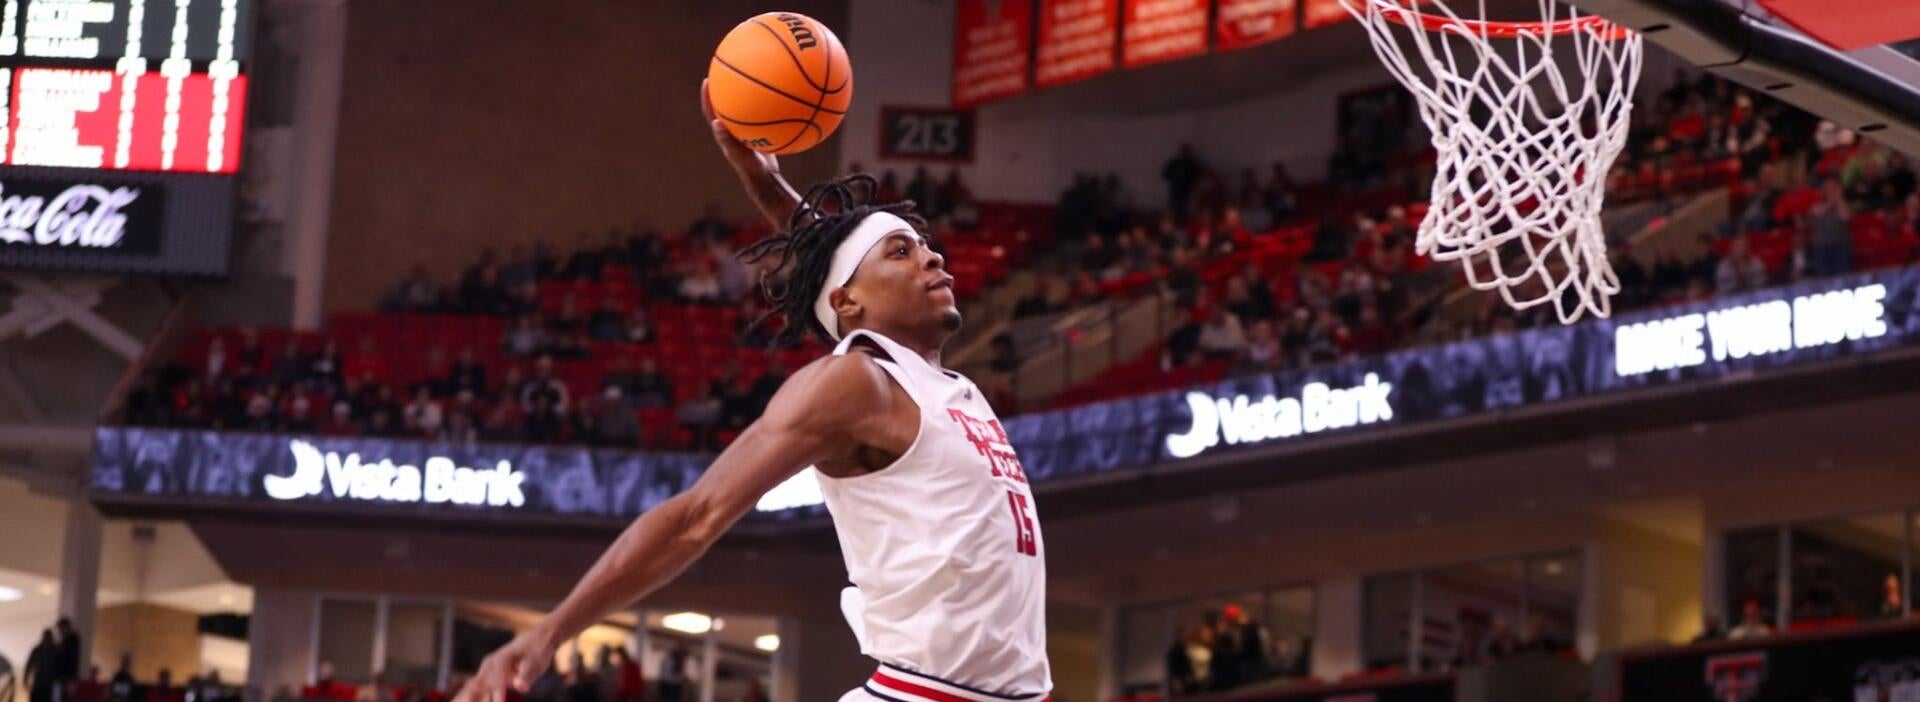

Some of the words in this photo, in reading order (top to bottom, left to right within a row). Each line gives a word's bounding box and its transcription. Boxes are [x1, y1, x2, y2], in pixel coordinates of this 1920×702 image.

[897, 117, 959, 151] 213
[1615, 313, 1706, 376] MAKE
[1707, 300, 1792, 361] YOUR
[1793, 284, 1887, 348] MOVE
[1218, 394, 1301, 444] Vista
[1303, 372, 1393, 433] Bank
[325, 452, 421, 502] Vista
[424, 456, 525, 507] Bank
[1007, 490, 1037, 557] 15
